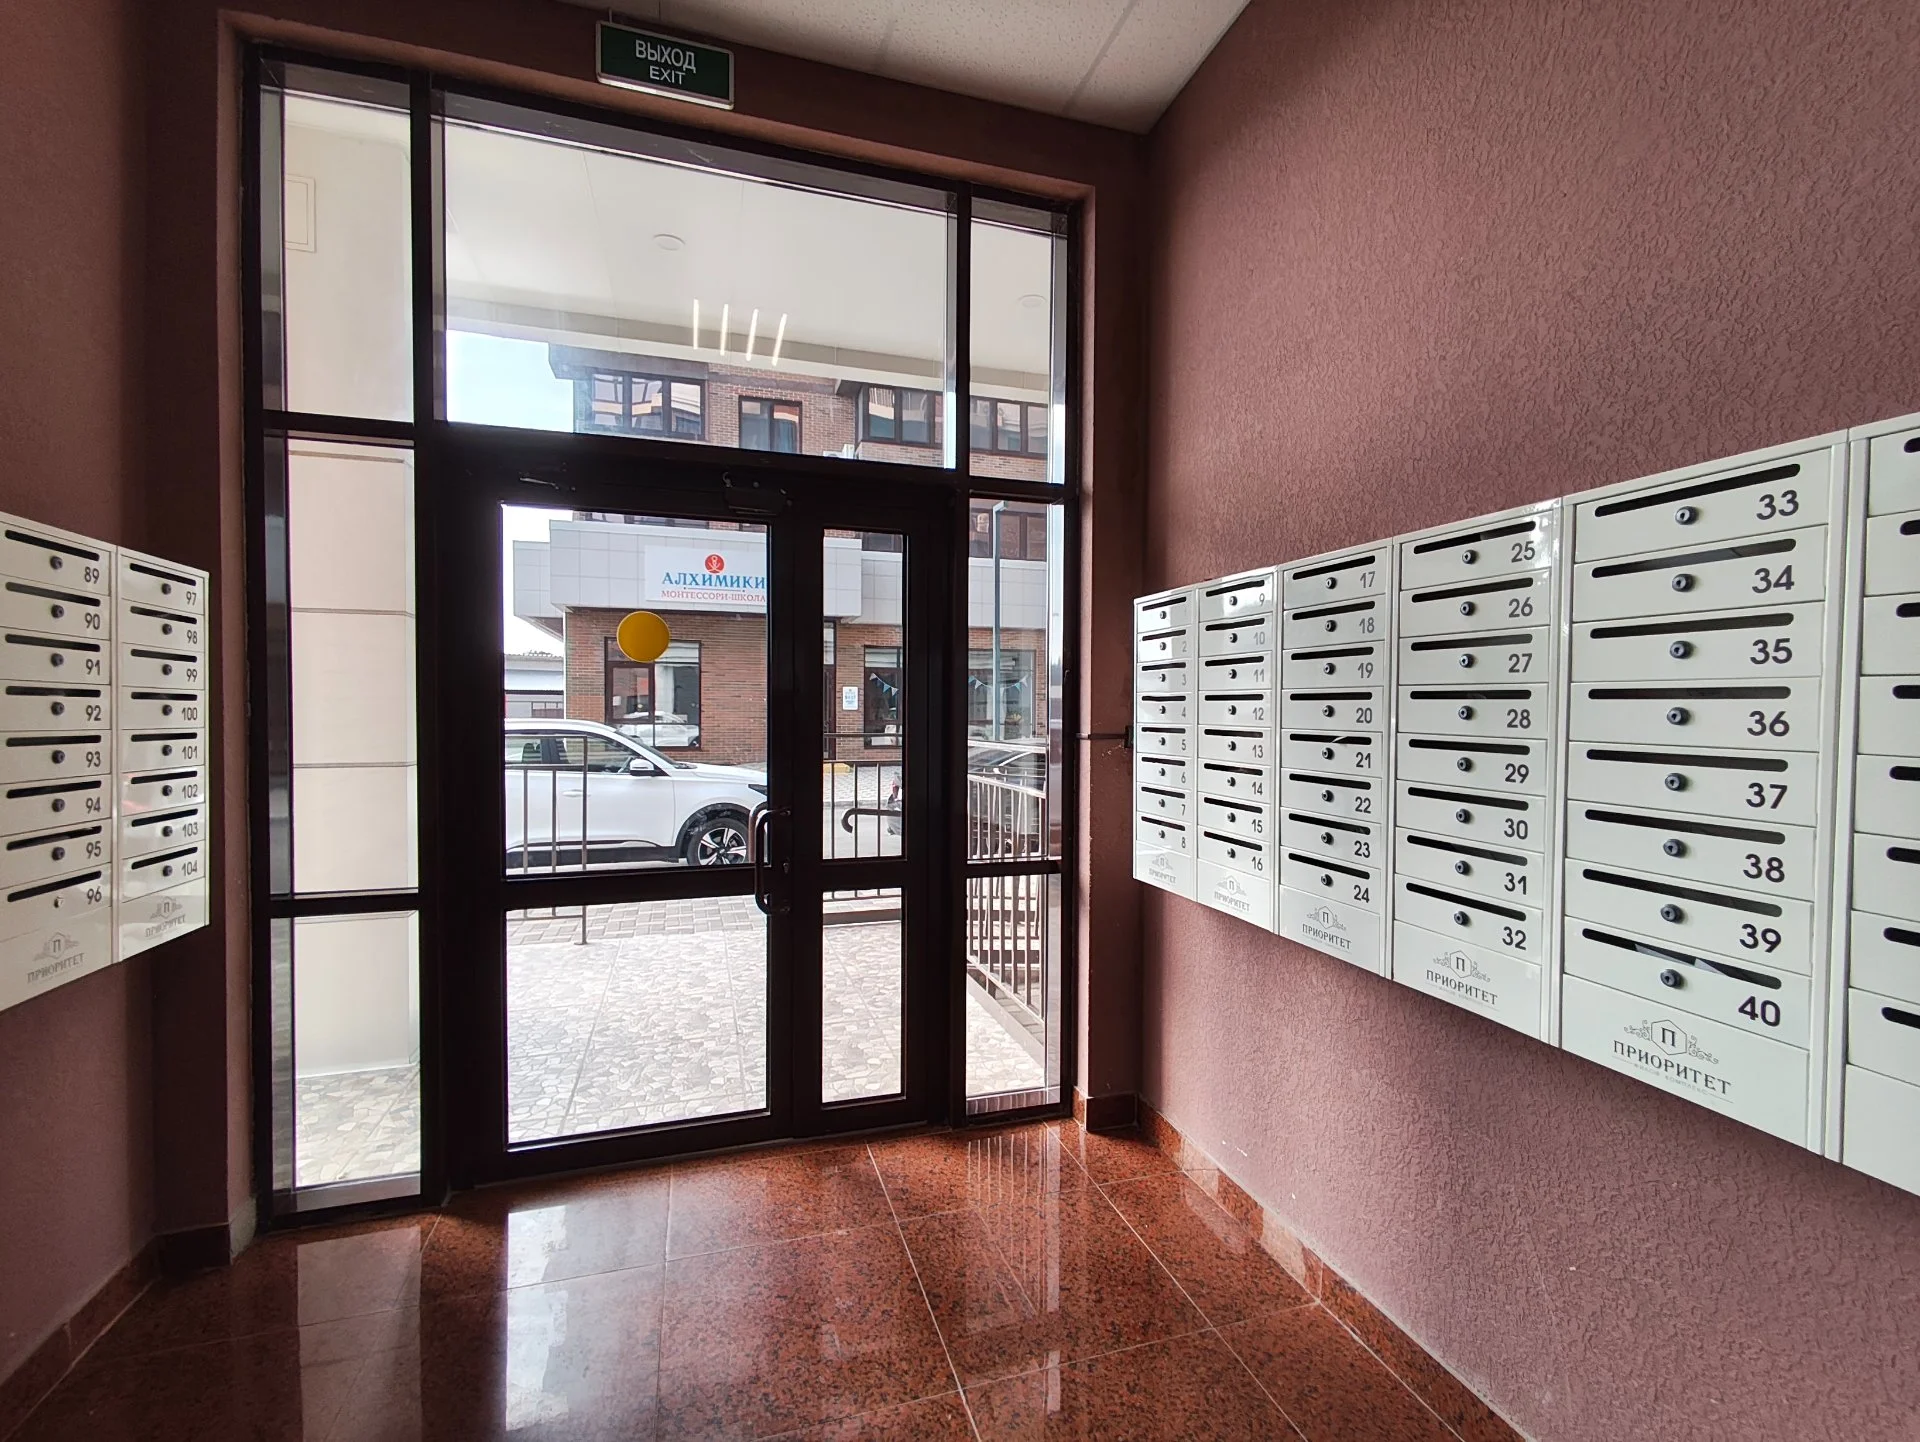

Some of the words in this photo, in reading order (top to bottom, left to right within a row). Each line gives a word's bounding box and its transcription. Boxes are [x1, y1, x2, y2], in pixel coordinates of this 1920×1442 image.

[635, 39, 697, 73] ВЫХОД
[649, 65, 686, 85] EXIT
[1756, 490, 1800, 520] 33
[1510, 541, 1536, 561] 25
[83, 567, 100, 584] 89
[661, 572, 766, 589] АЛХИМИКИ
[1359, 571, 1376, 588] 17
[1751, 565, 1795, 593] 34
[185, 591, 197, 605] 97
[661, 590, 766, 603] МОНТЕССОРИ-ШКОЛА
[1258, 593, 1266, 607] 9
[1508, 597, 1534, 618] 26
[84, 613, 101, 630] 90
[1358, 617, 1375, 633] 18
[186, 630, 198, 644] 98
[1253, 632, 1266, 645] 10
[1181, 641, 1188, 652] 2
[1750, 638, 1793, 664] 35
[85, 659, 101, 675] 91
[1357, 663, 1374, 678] 19
[1508, 653, 1533, 673] 27
[186, 669, 198, 682] 99
[1181, 674, 1187, 686] 3
[1253, 669, 1265, 682] 11
[85, 705, 102, 721] 92
[181, 707, 198, 720] 100
[1181, 707, 1187, 717] 4
[1252, 707, 1265, 720] 12
[1355, 708, 1373, 723] 20
[1506, 709, 1532, 729] 28
[1746, 711, 1790, 736] 36
[181, 746, 198, 759] 101
[1181, 739, 1187, 750] 5
[1252, 745, 1264, 758] 13
[85, 751, 101, 767] 93
[1355, 752, 1371, 768] 21
[1180, 772, 1187, 783] 6
[1504, 763, 1530, 783] 29
[181, 784, 199, 798] 102
[1251, 782, 1263, 795] 14
[1745, 783, 1788, 809] 37
[85, 797, 102, 814] 94
[1181, 804, 1186, 815] 7
[1354, 797, 1372, 813] 22
[181, 822, 199, 837] 103
[1251, 819, 1263, 833] 15
[1503, 818, 1529, 839] 30
[85, 841, 102, 858] 95
[1181, 837, 1186, 848] 8
[1354, 841, 1371, 858] 23
[181, 860, 198, 876] 104
[1251, 856, 1264, 871] 16
[1742, 854, 1786, 882] 38
[1503, 873, 1527, 895] 31
[86, 887, 103, 905] 96
[1353, 885, 1370, 903] 24
[1322, 911, 1329, 924] П
[1302, 923, 1352, 950] ПРИОРИТЕТ
[1502, 927, 1527, 950] 32
[1739, 924, 1782, 953] 39
[27, 952, 85, 984] ПРИОРИТЕТ
[1456, 956, 1466, 972] П
[1426, 969, 1498, 1005] ПРИОРИТЕТ
[1736, 997, 1781, 1029] 40
[1661, 1027, 1677, 1048] П
[1612, 1039, 1732, 1095] ПРИОРИТЕТ
